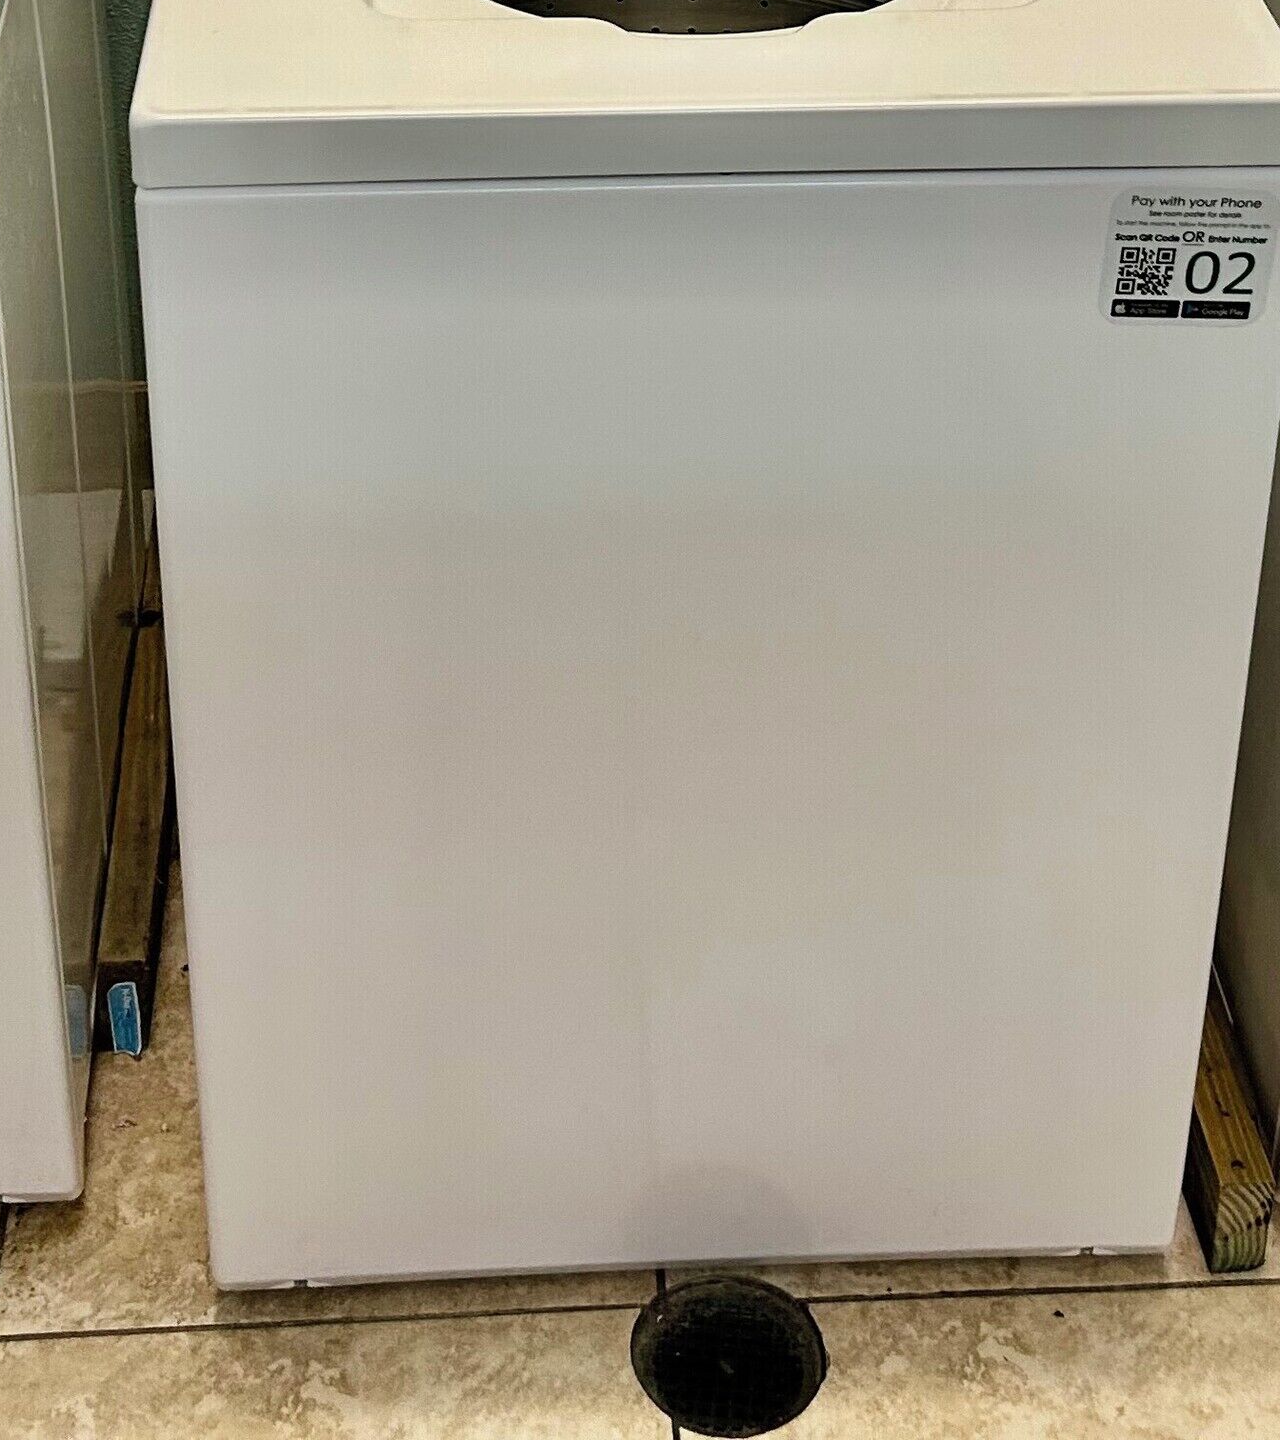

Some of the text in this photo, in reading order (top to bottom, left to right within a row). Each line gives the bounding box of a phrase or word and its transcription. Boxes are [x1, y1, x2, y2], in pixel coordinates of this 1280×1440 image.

[1131, 194, 1262, 209] Pay with your Phone
[1115, 230, 1268, 244] Scan QR Code OR Enter Number
[1184, 250, 1256, 295] 02
